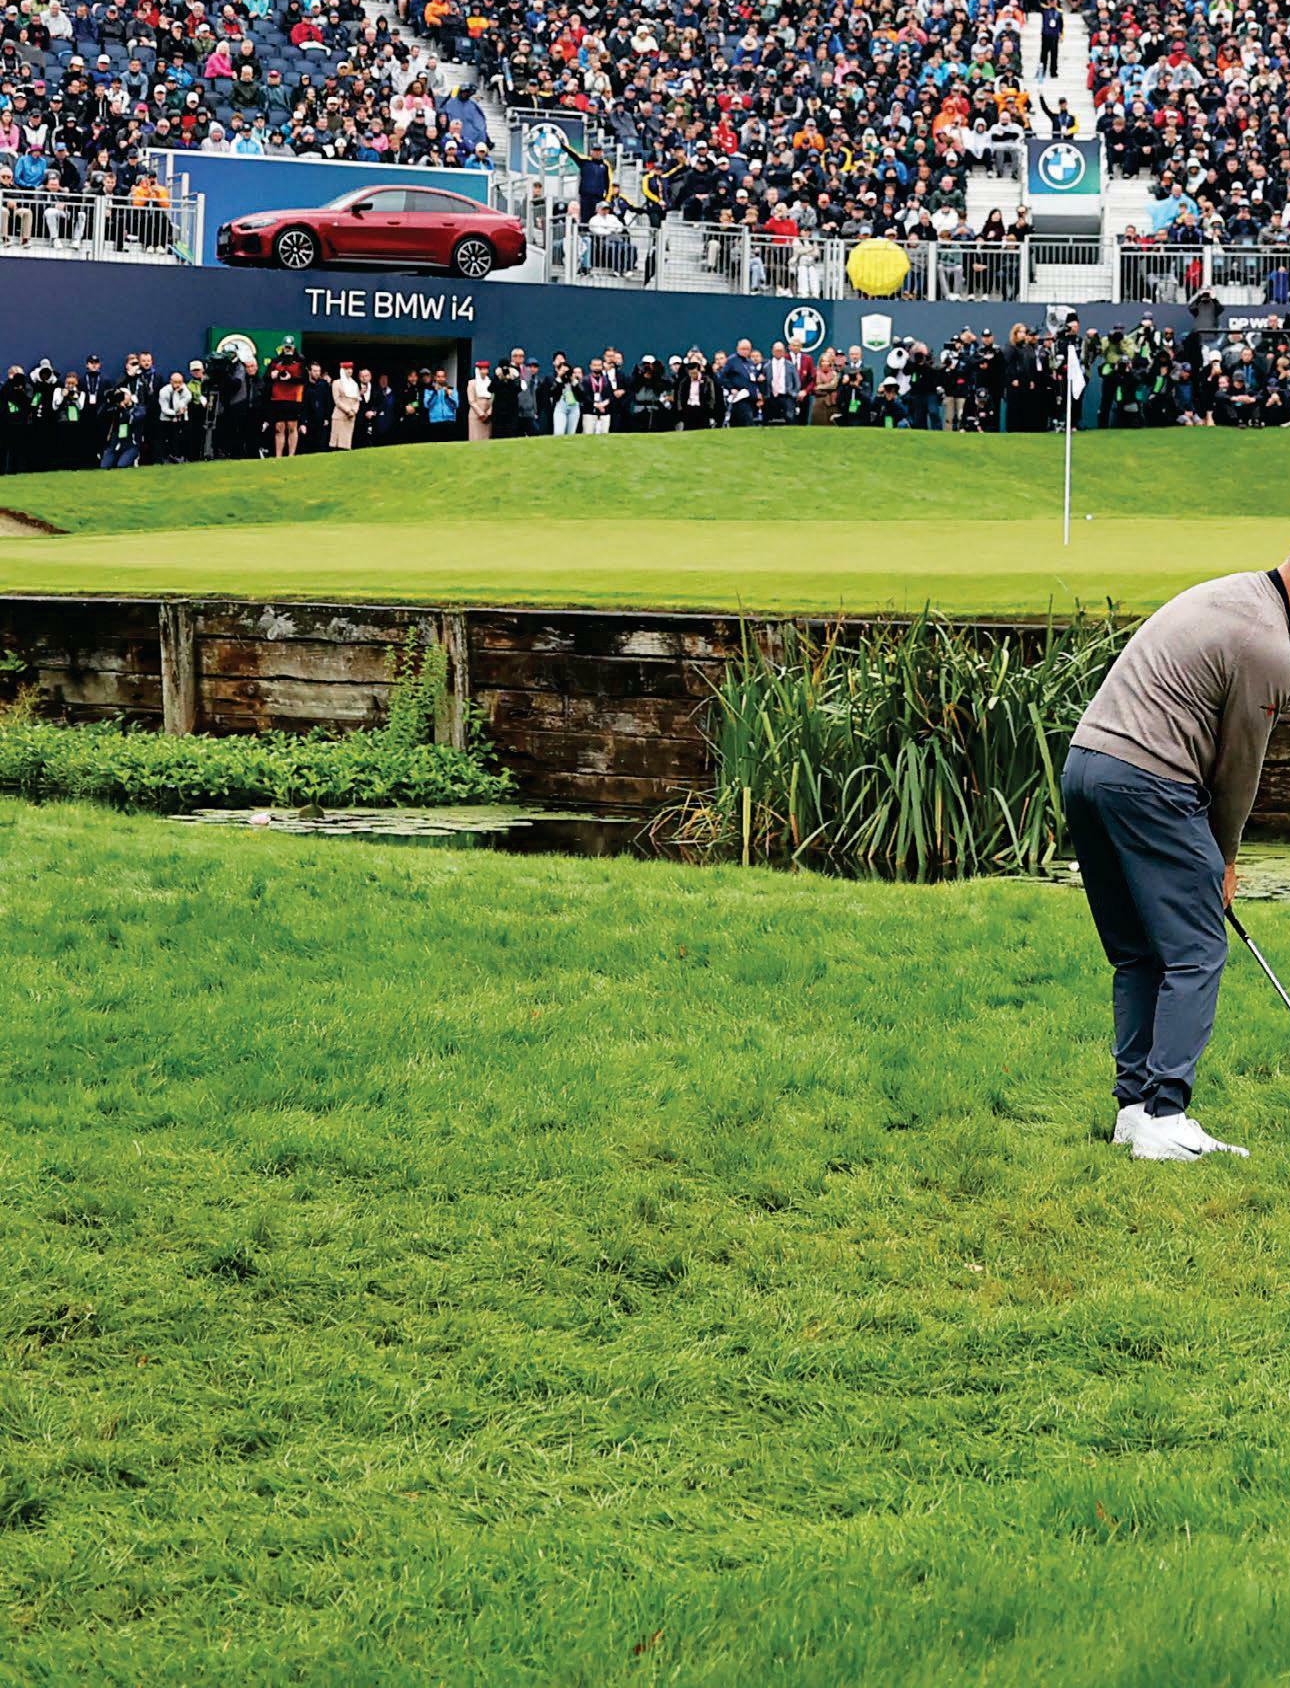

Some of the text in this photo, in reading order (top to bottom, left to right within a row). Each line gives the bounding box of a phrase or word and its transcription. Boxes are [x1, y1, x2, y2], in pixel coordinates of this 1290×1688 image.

[305, 288, 474, 322] THE BMW i4
[1229, 318, 1249, 331] DP
